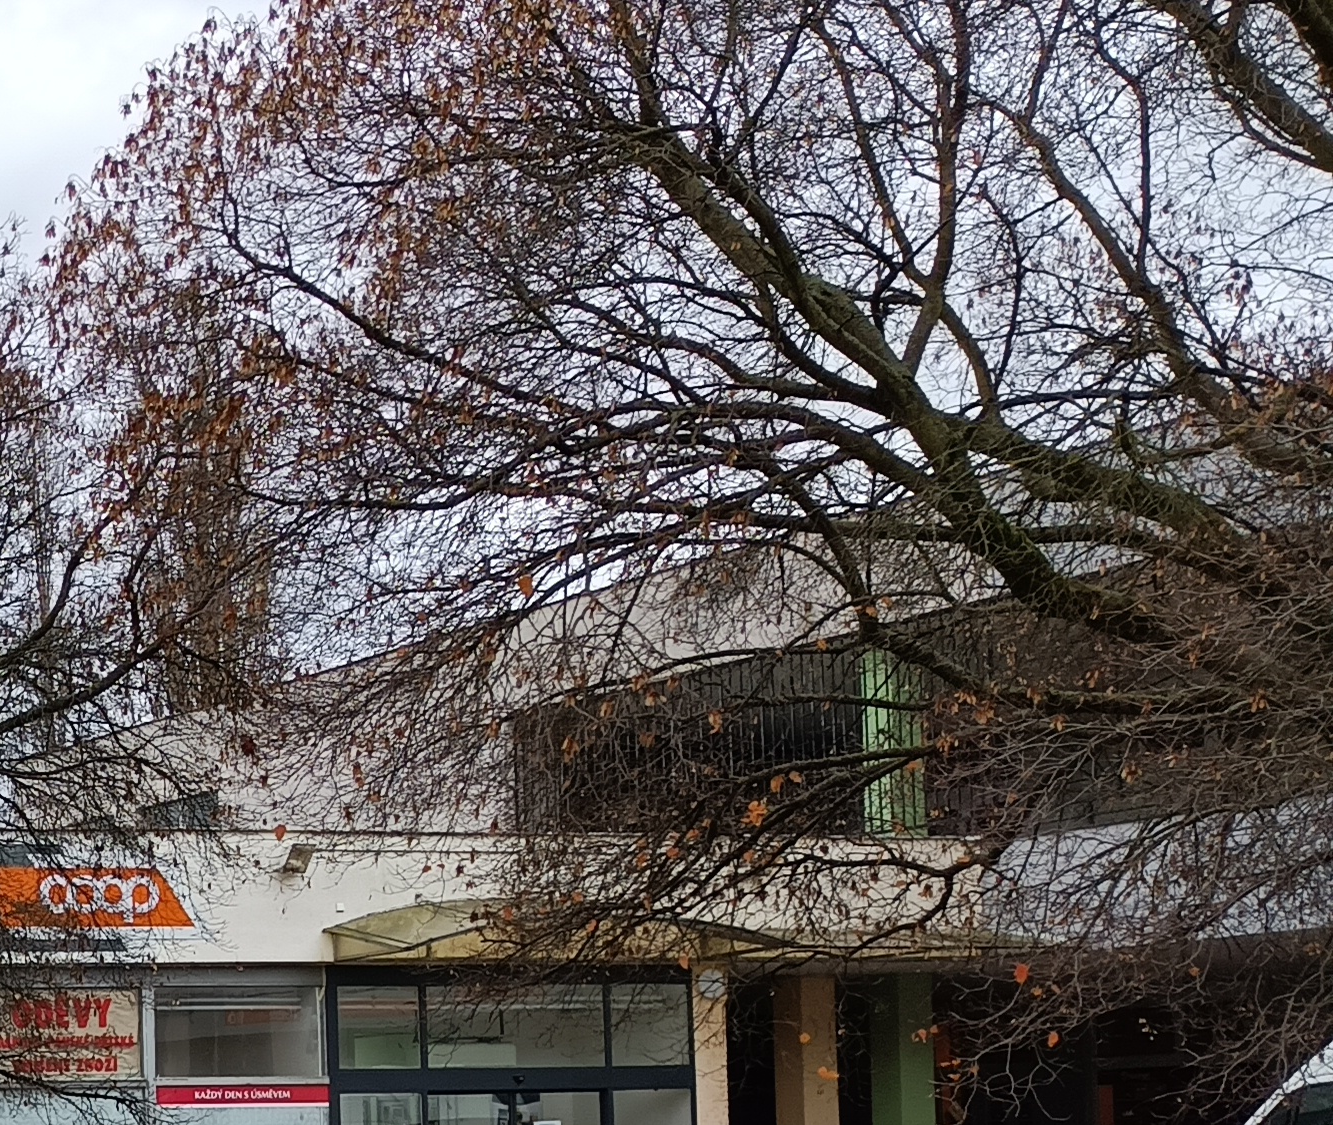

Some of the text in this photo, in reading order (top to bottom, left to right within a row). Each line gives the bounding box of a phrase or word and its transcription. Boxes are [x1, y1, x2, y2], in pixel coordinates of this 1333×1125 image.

[39, 874, 160, 923] coop
[194, 1088, 291, 1100] KAŽDÝ DEN S ÚSMĚVEM
